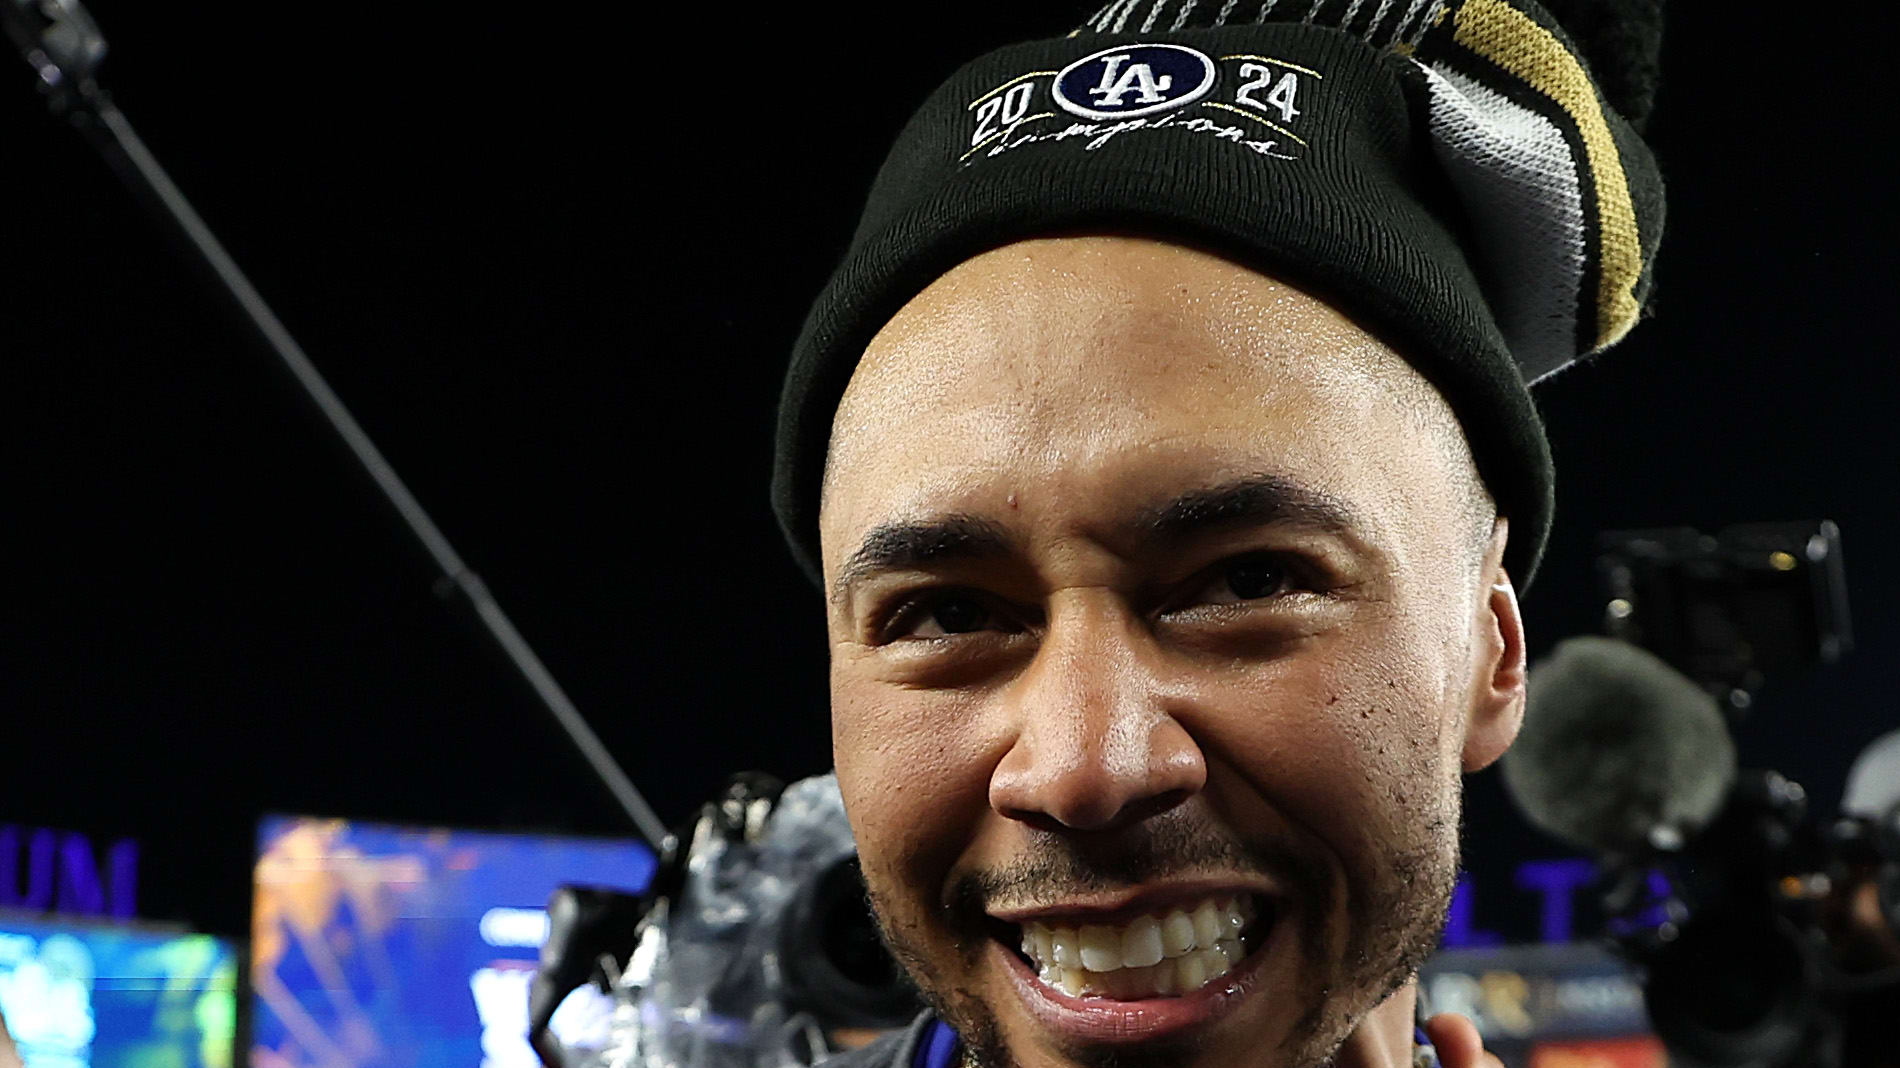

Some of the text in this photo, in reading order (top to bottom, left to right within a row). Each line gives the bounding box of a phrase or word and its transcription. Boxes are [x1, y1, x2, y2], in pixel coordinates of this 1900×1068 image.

[970, 54, 1300, 147] 20 LA 24
